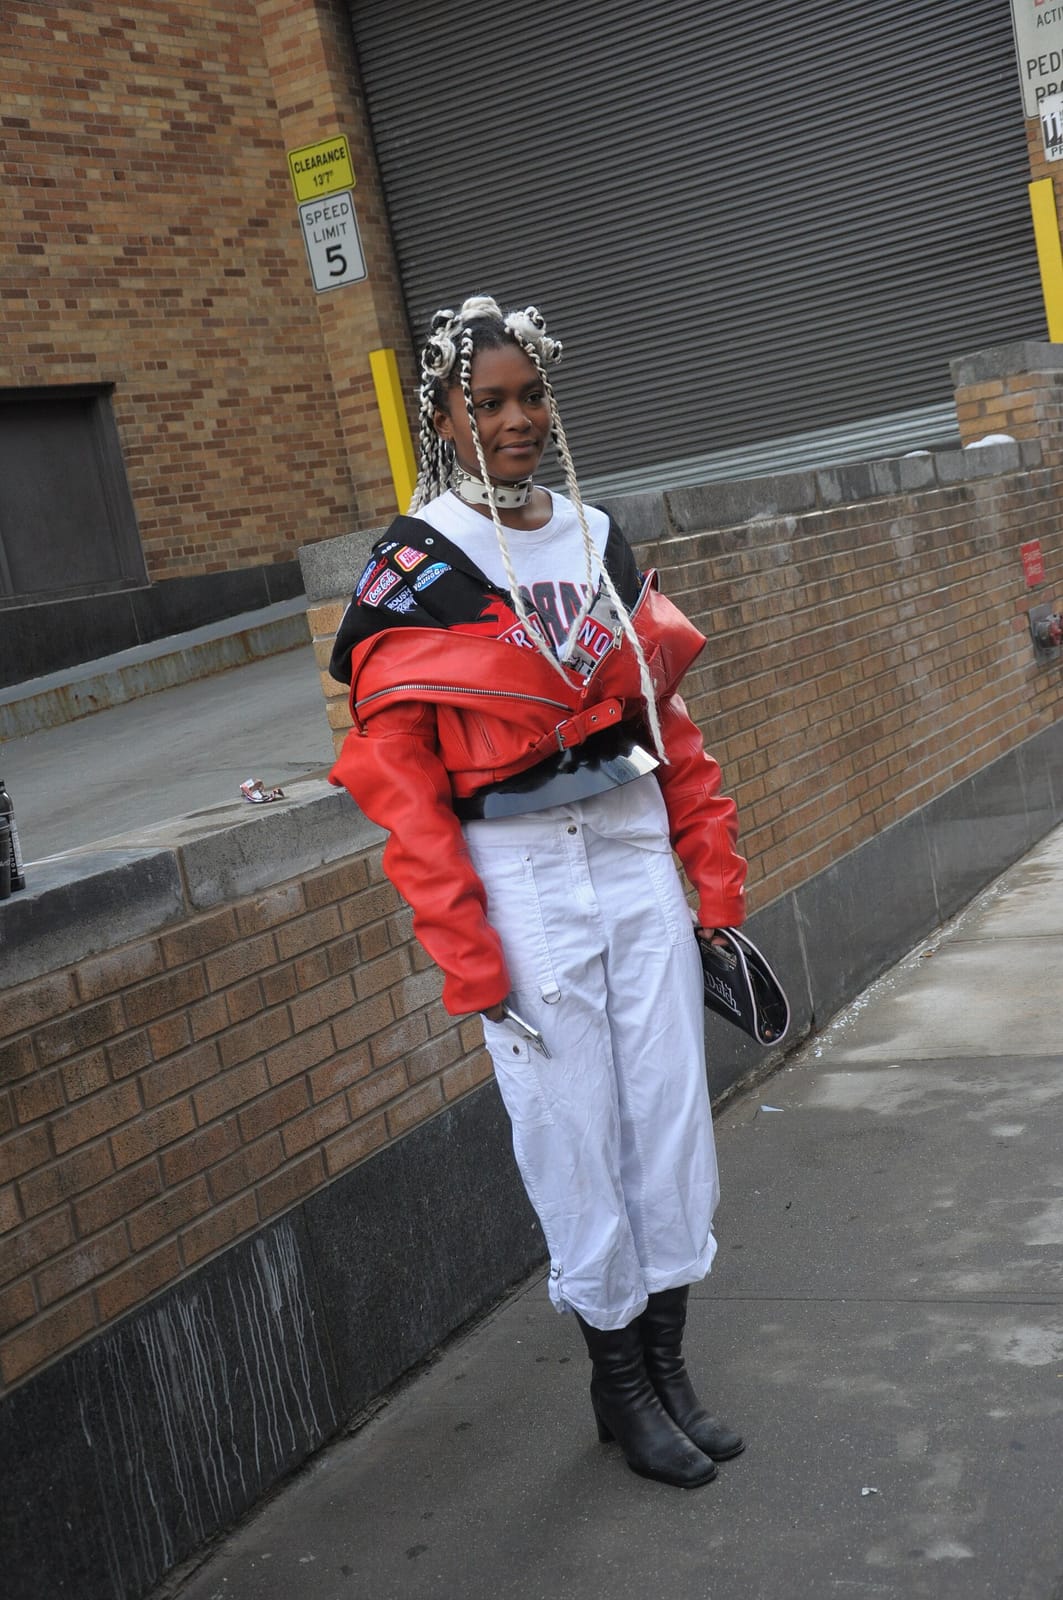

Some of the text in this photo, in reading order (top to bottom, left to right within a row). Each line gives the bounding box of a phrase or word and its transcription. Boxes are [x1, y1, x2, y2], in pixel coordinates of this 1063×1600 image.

[1036, 6, 1063, 28] ACTI
[1026, 49, 1063, 80] PED
[1035, 80, 1063, 104] PR
[294, 147, 345, 174] CLEARANCE
[305, 202, 349, 226] SPEED
[313, 222, 347, 244] LIMIT
[325, 244, 348, 277] 5
[386, 587, 412, 610] ROUSH
